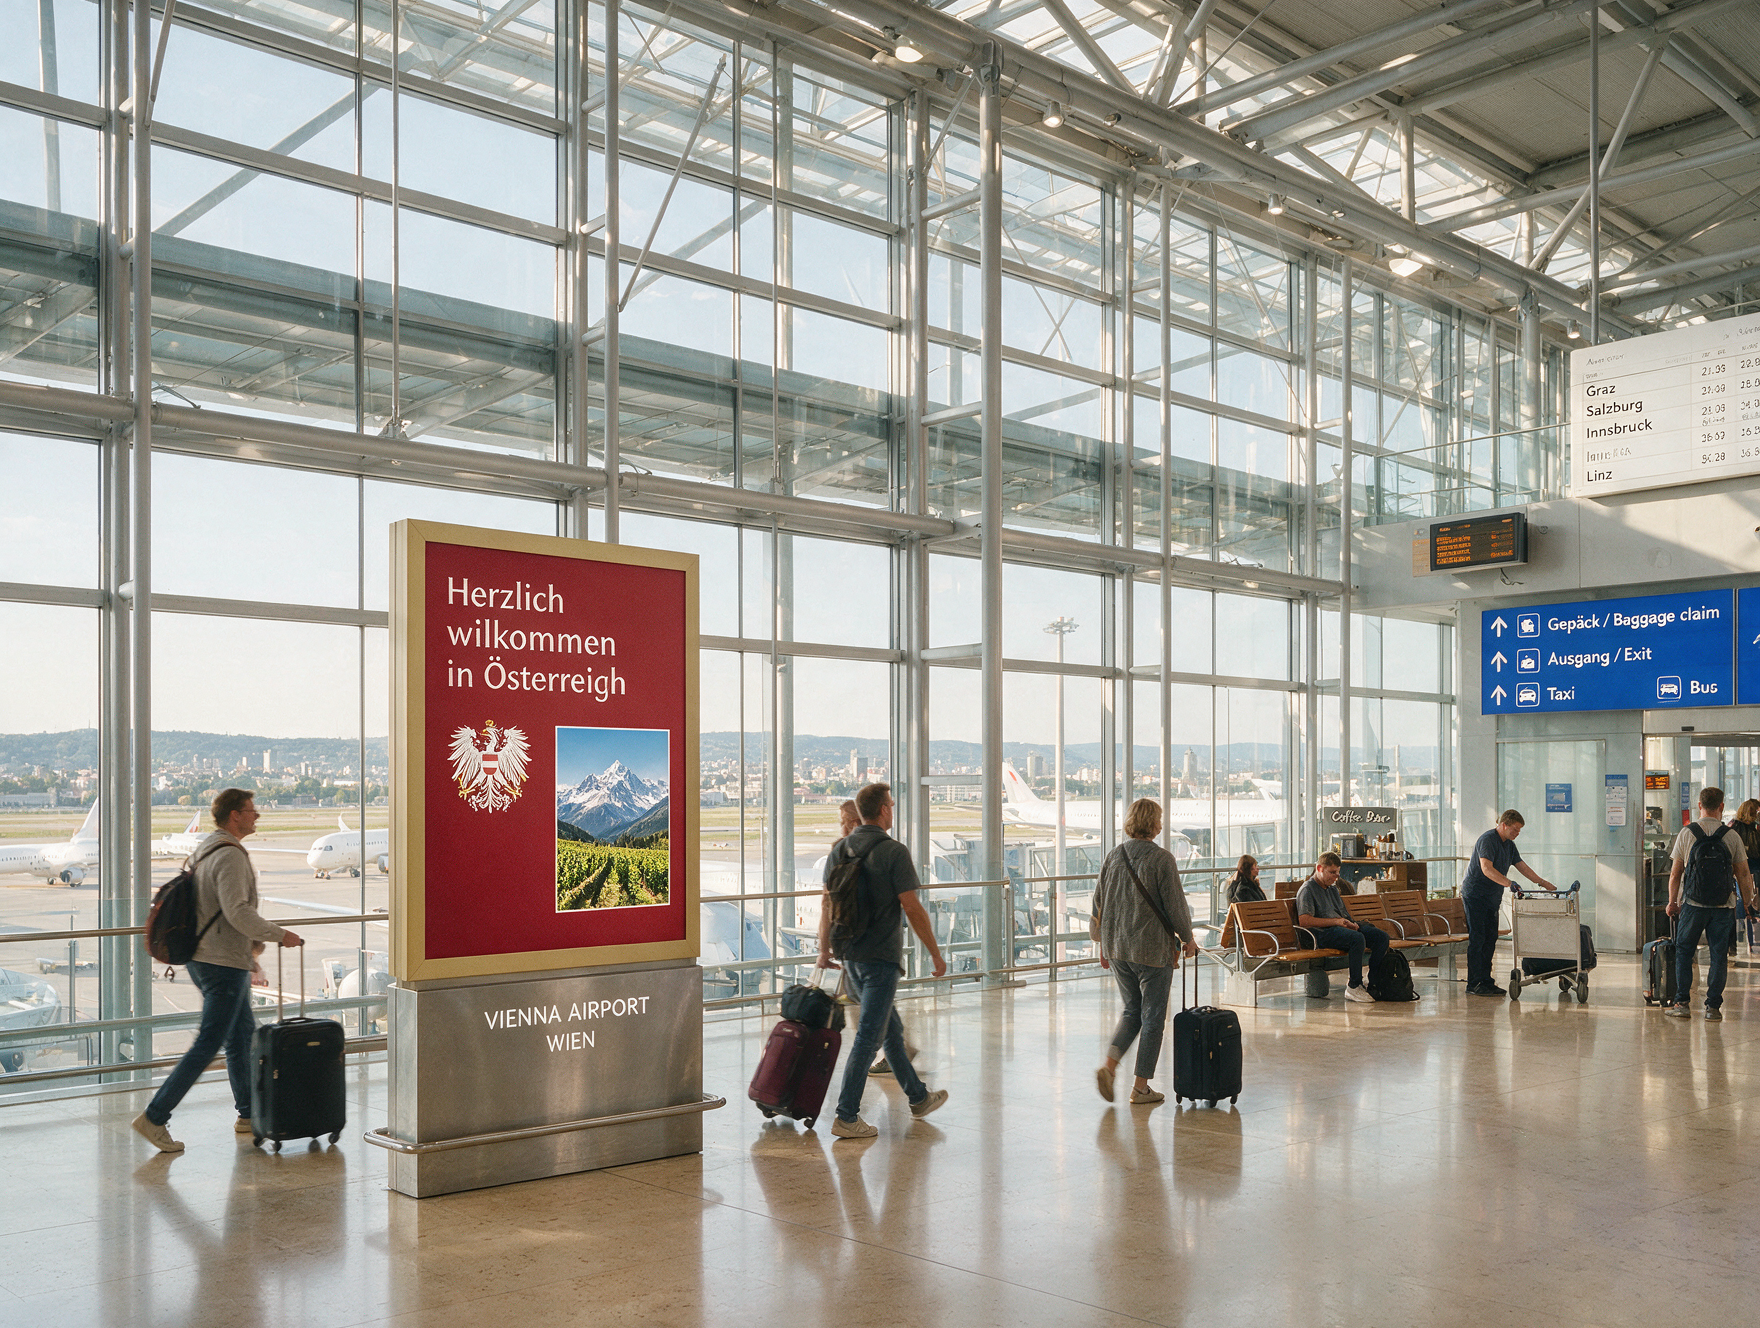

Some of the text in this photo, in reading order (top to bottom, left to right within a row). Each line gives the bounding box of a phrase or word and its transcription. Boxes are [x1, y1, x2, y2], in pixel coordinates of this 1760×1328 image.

[1586, 385, 1616, 397] Graz
[1586, 400, 1643, 417] Salzburg
[1586, 419, 1653, 439] Innsbruck
[1587, 470, 1613, 482] Linz
[447, 576, 564, 614] Herzlich
[1547, 605, 1720, 634] Gepäck / Baggage claim
[446, 618, 616, 657] wilkommen
[1547, 646, 1653, 668] Ausgang / Exit
[448, 655, 626, 703] in Österreigh
[1690, 680, 1718, 695] Bus
[1546, 686, 1575, 701] Taxi
[484, 996, 650, 1030] VIENNA AIRPORT
[546, 1030, 595, 1053] WIEN
